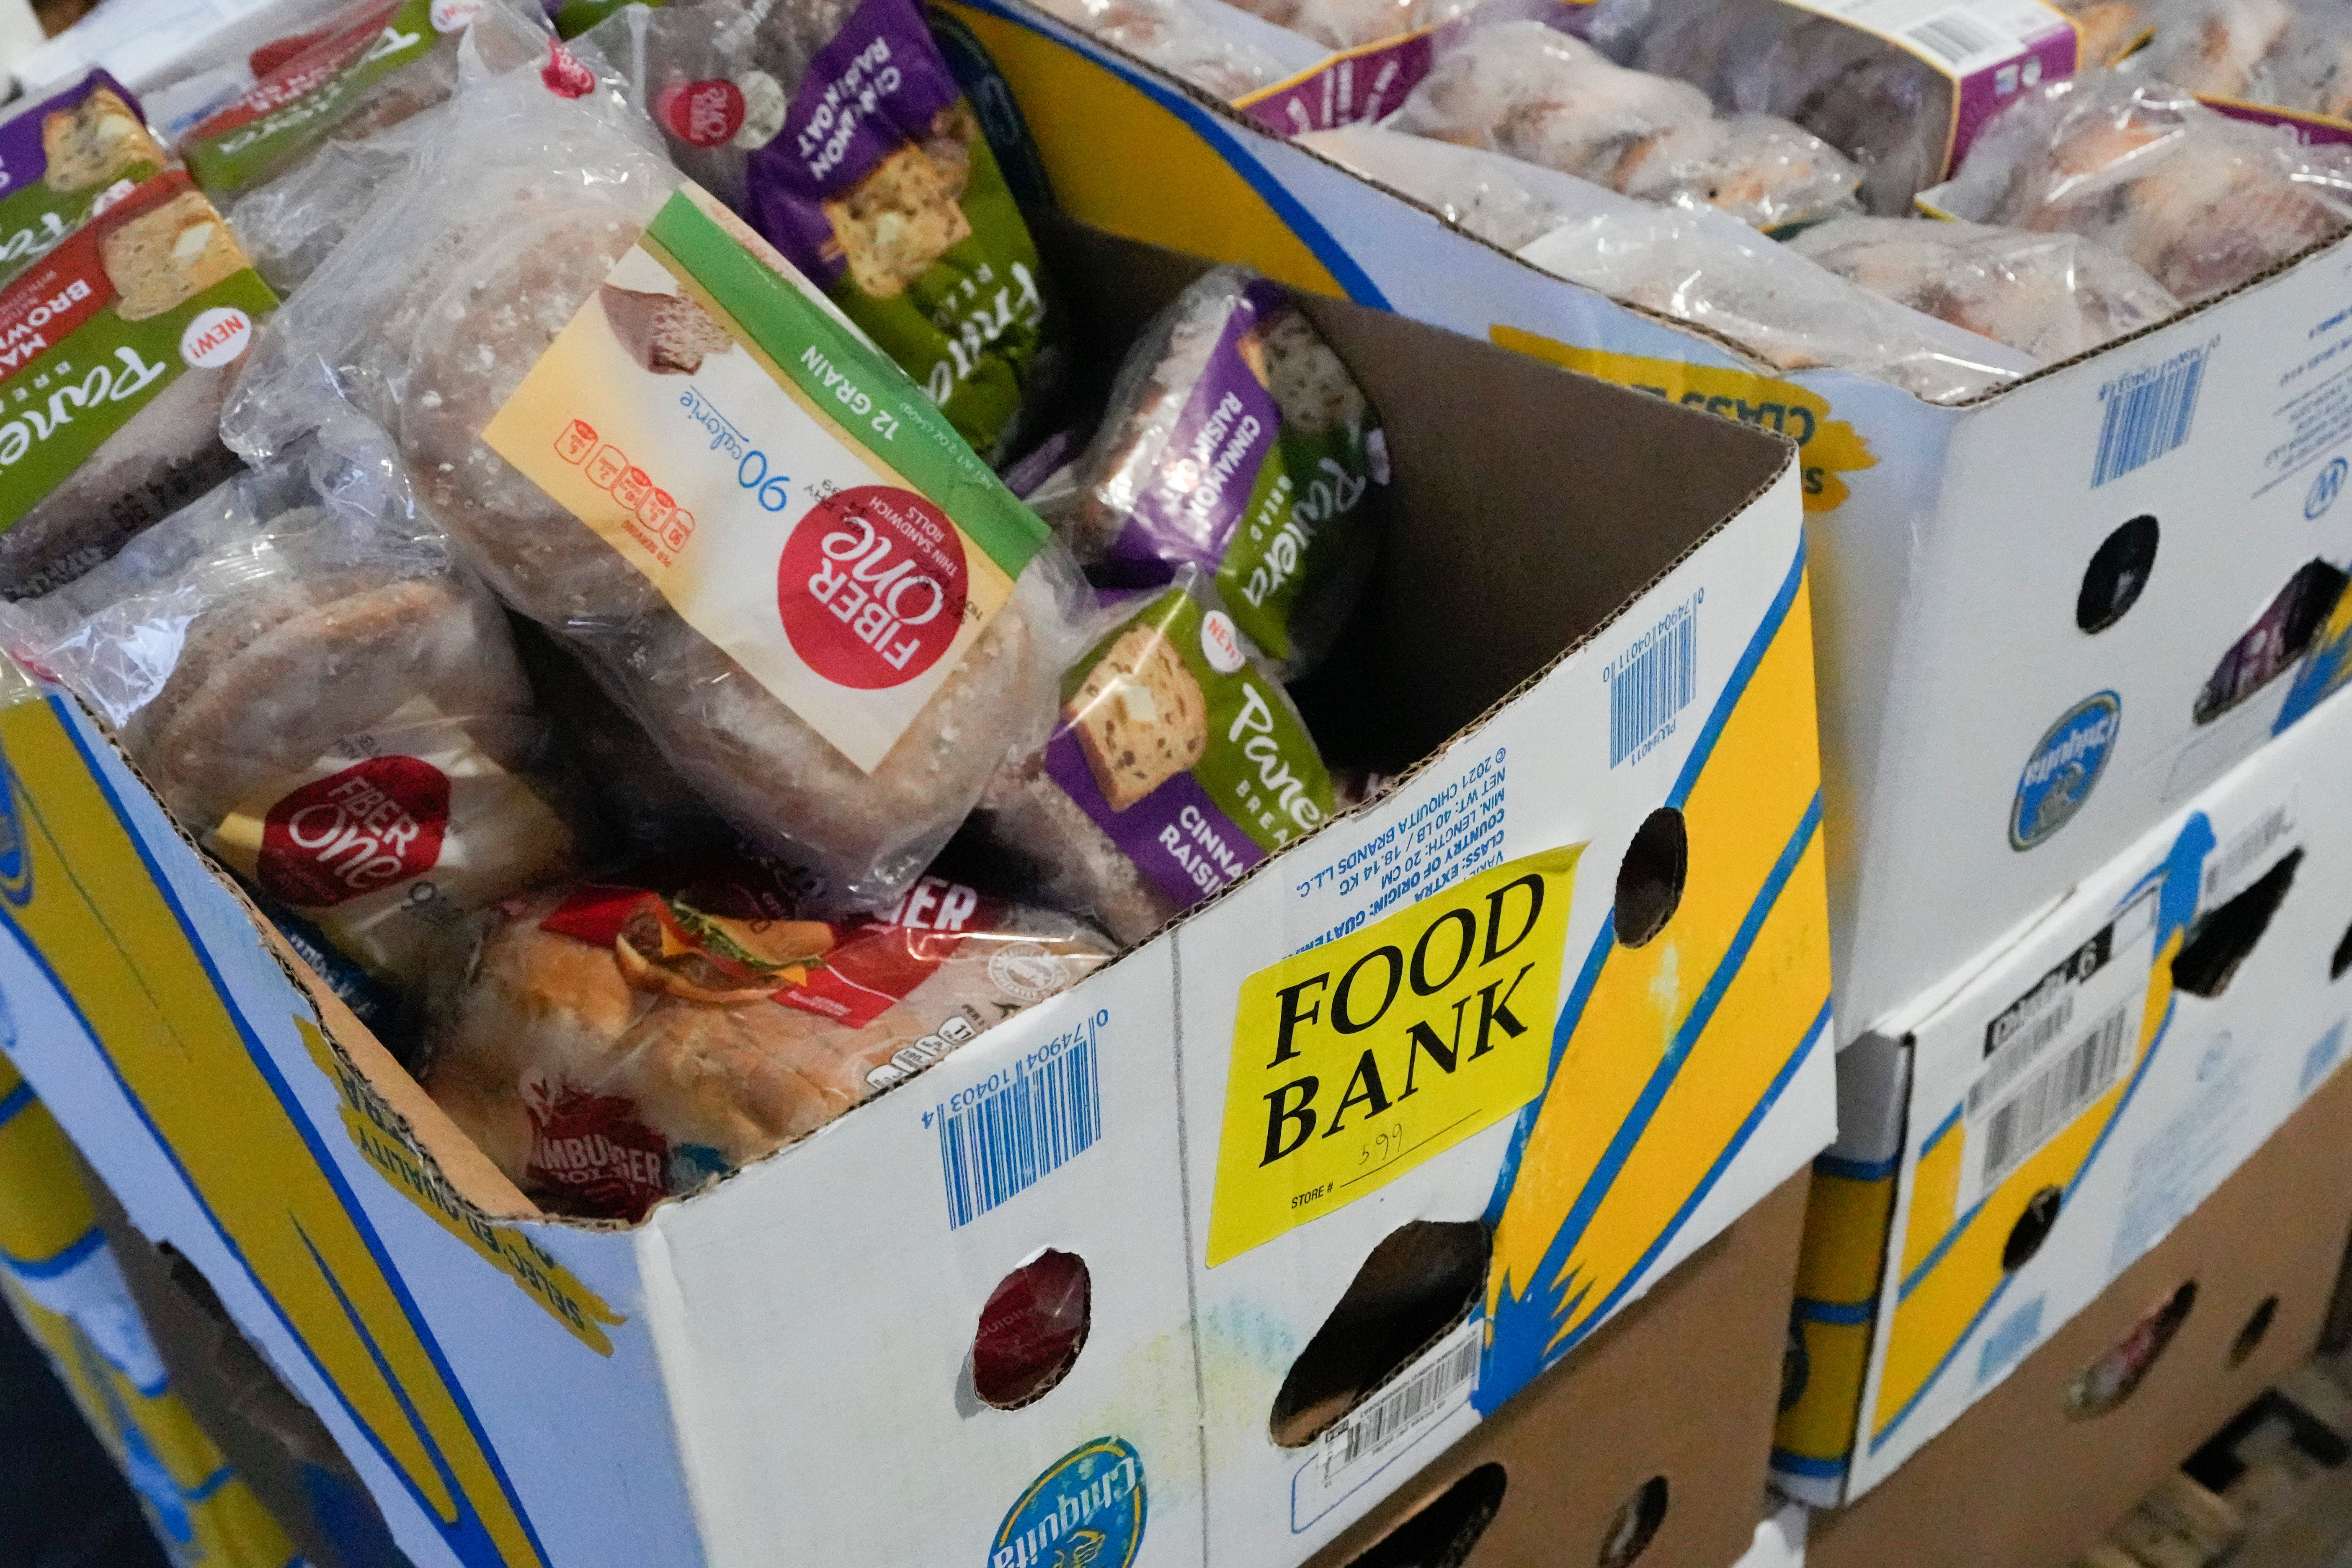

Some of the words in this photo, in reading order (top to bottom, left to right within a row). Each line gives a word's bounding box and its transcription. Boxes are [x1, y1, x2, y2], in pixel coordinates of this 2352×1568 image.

[0, 333, 47, 376] MA
[193, 315, 244, 358] NEW!
[0, 361, 71, 414] BRE
[801, 344, 872, 415] GRAIN
[0, 346, 165, 466] Pane
[681, 391, 745, 461] calorie
[872, 410, 900, 442] 12
[739, 450, 790, 512] 90
[1190, 415, 1261, 516] CINNAMON
[867, 494, 935, 555] SANDWICH
[904, 504, 946, 544] ROLLS
[1242, 457, 1366, 607] Panera
[821, 516, 944, 625] One
[928, 547, 959, 578] THIN
[808, 557, 921, 671] FIBER
[1657, 599, 1691, 637] 74904
[1620, 632, 1651, 670] 04011
[1228, 682, 1328, 831] Pane
[1462, 757, 1491, 788] 2021
[1455, 789, 1478, 813] WT:
[1480, 788, 1505, 815] MIN.
[1481, 767, 1506, 796] NET
[328, 776, 419, 856] FIBER
[1398, 784, 1457, 834] CHIQUITA
[1436, 810, 1452, 830] 40
[289, 804, 402, 889] One
[1338, 826, 1395, 874] BRANDS
[1417, 822, 1432, 843] LB
[1445, 808, 1505, 863] COUNTRY
[1462, 829, 1504, 869] CLASS:
[1364, 846, 1400, 881] 18.14
[1381, 865, 1401, 890] CM
[1405, 851, 1421, 872] 20
[1414, 863, 1459, 902] EXTRA
[1424, 856, 1441, 879] OF
[1369, 871, 1421, 916] ORIGIN:
[1266, 872, 1546, 1070] FOOD
[1026, 1022, 1084, 1071] 74904
[1258, 962, 1535, 1168] BANK
[950, 1067, 1009, 1112] 10403
[1358, 1123, 1403, 1166] 599
[1291, 1184, 1324, 1210] STORE
